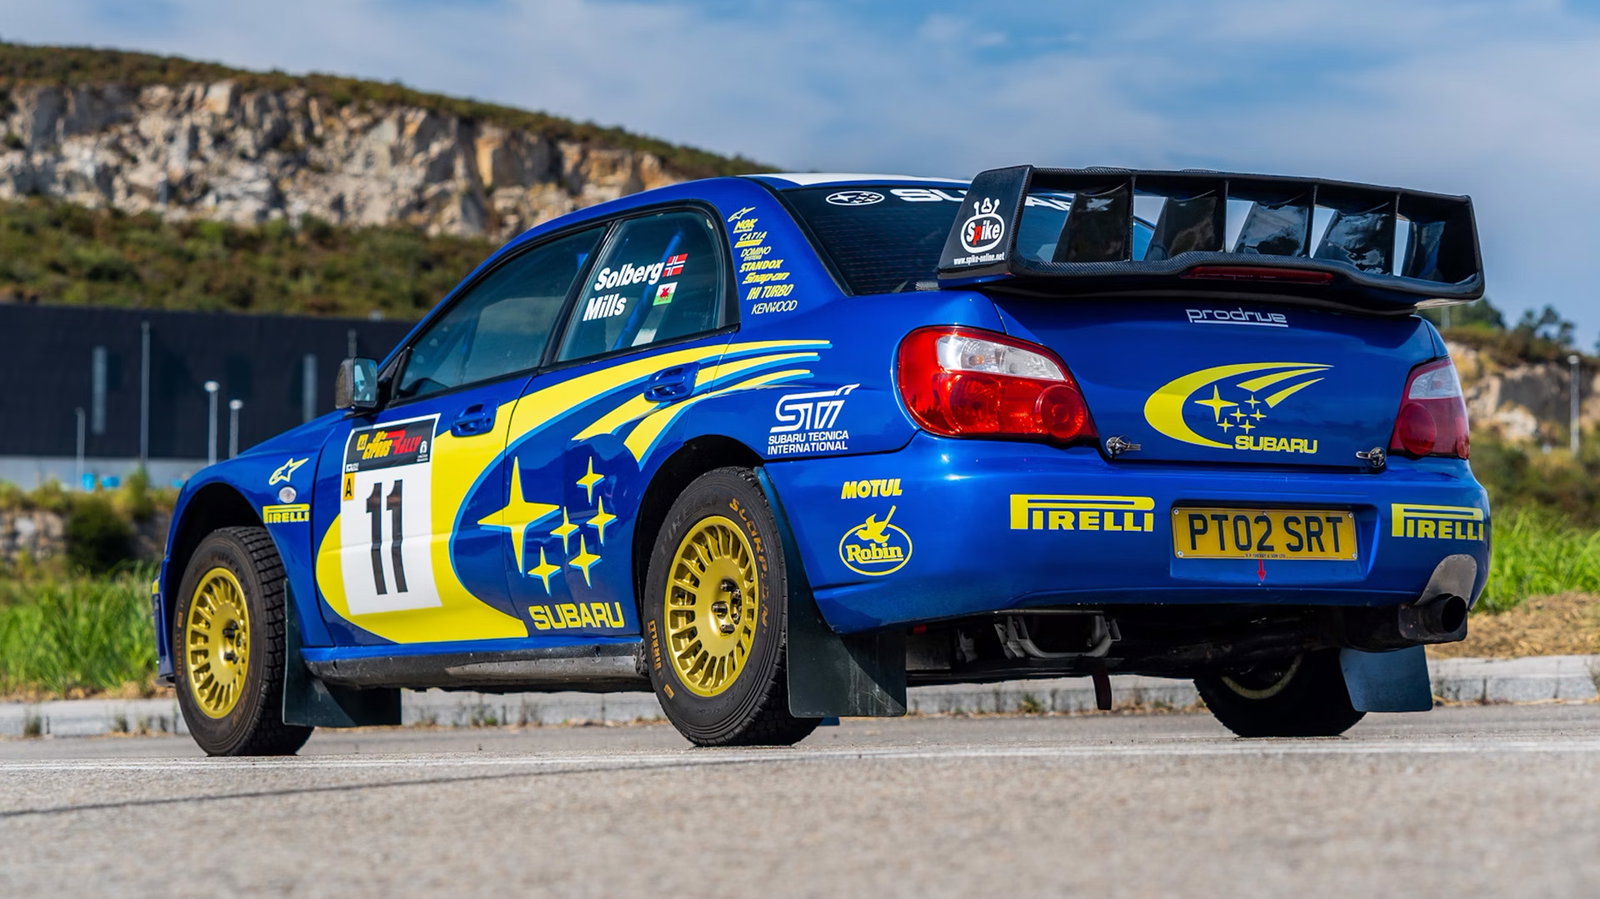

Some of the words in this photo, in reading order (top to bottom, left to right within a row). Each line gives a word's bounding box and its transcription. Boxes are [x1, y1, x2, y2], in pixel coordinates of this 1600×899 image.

[740, 232, 767, 241] CATIA
[966, 220, 1001, 246] Spike
[740, 246, 772, 257] DOMINO
[953, 252, 1005, 266] www.spike-online.net
[739, 259, 784, 273] STANDOX
[594, 262, 665, 291] Solberg
[742, 272, 790, 285] Snap-on
[746, 286, 762, 301] IHI
[761, 284, 794, 299] TURBO
[583, 293, 627, 322] Mills
[751, 300, 798, 315] KENWOOD
[1186, 308, 1288, 325] prodrive
[768, 433, 806, 445] SUBARU
[808, 430, 849, 442] TECNICA
[1235, 435, 1318, 454] SUBARU
[767, 441, 849, 456] INTERNATIONAL
[345, 478, 352, 497] A
[841, 478, 903, 499] MOTUL
[262, 503, 310, 524] PIRELLI
[1010, 494, 1155, 532] PIRELLI
[1391, 503, 1484, 541] PIRELLI
[366, 479, 408, 596] 11
[1188, 513, 1275, 552] PT02
[1283, 515, 1343, 553] SRT
[845, 542, 904, 564] Robin
[528, 601, 625, 630] SUBARU
